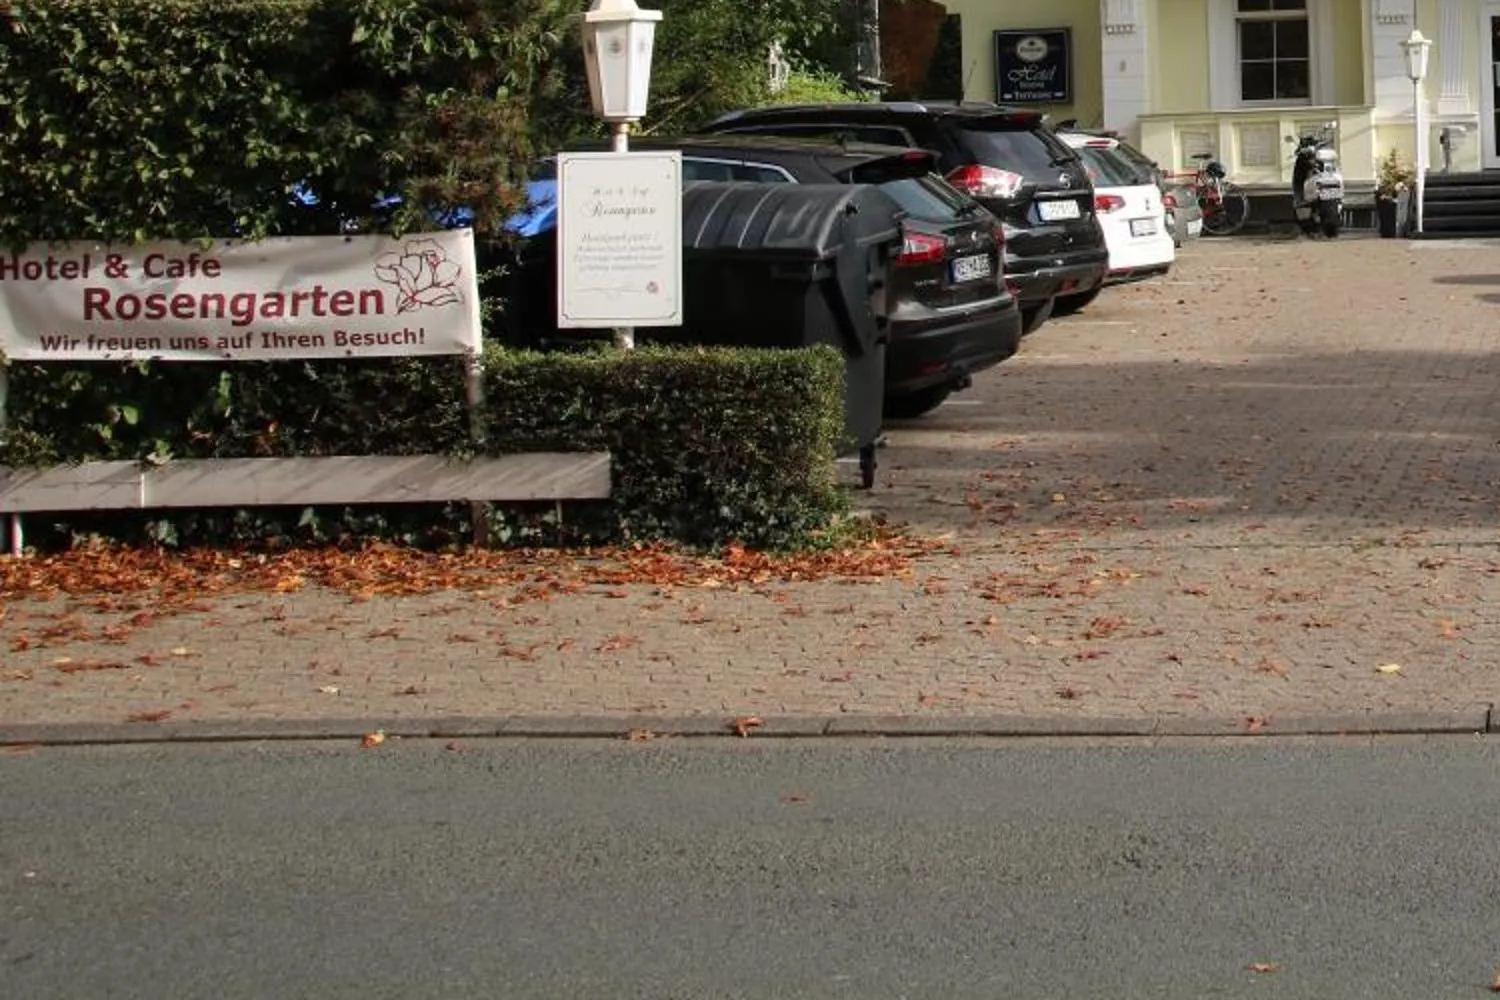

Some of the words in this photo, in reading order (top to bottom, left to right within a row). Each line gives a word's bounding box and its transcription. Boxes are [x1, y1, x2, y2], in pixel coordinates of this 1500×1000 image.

[0, 253, 91, 281] Hotel
[103, 253, 129, 279] &
[143, 253, 221, 279] Cafe
[83, 285, 384, 327] Rosengarten
[40, 334, 81, 351] Wir
[87, 333, 161, 351] freuen
[169, 336, 209, 350] uns
[216, 331, 253, 350] auf
[262, 331, 325, 349] Ihren
[334, 328, 425, 347] Besuch!
